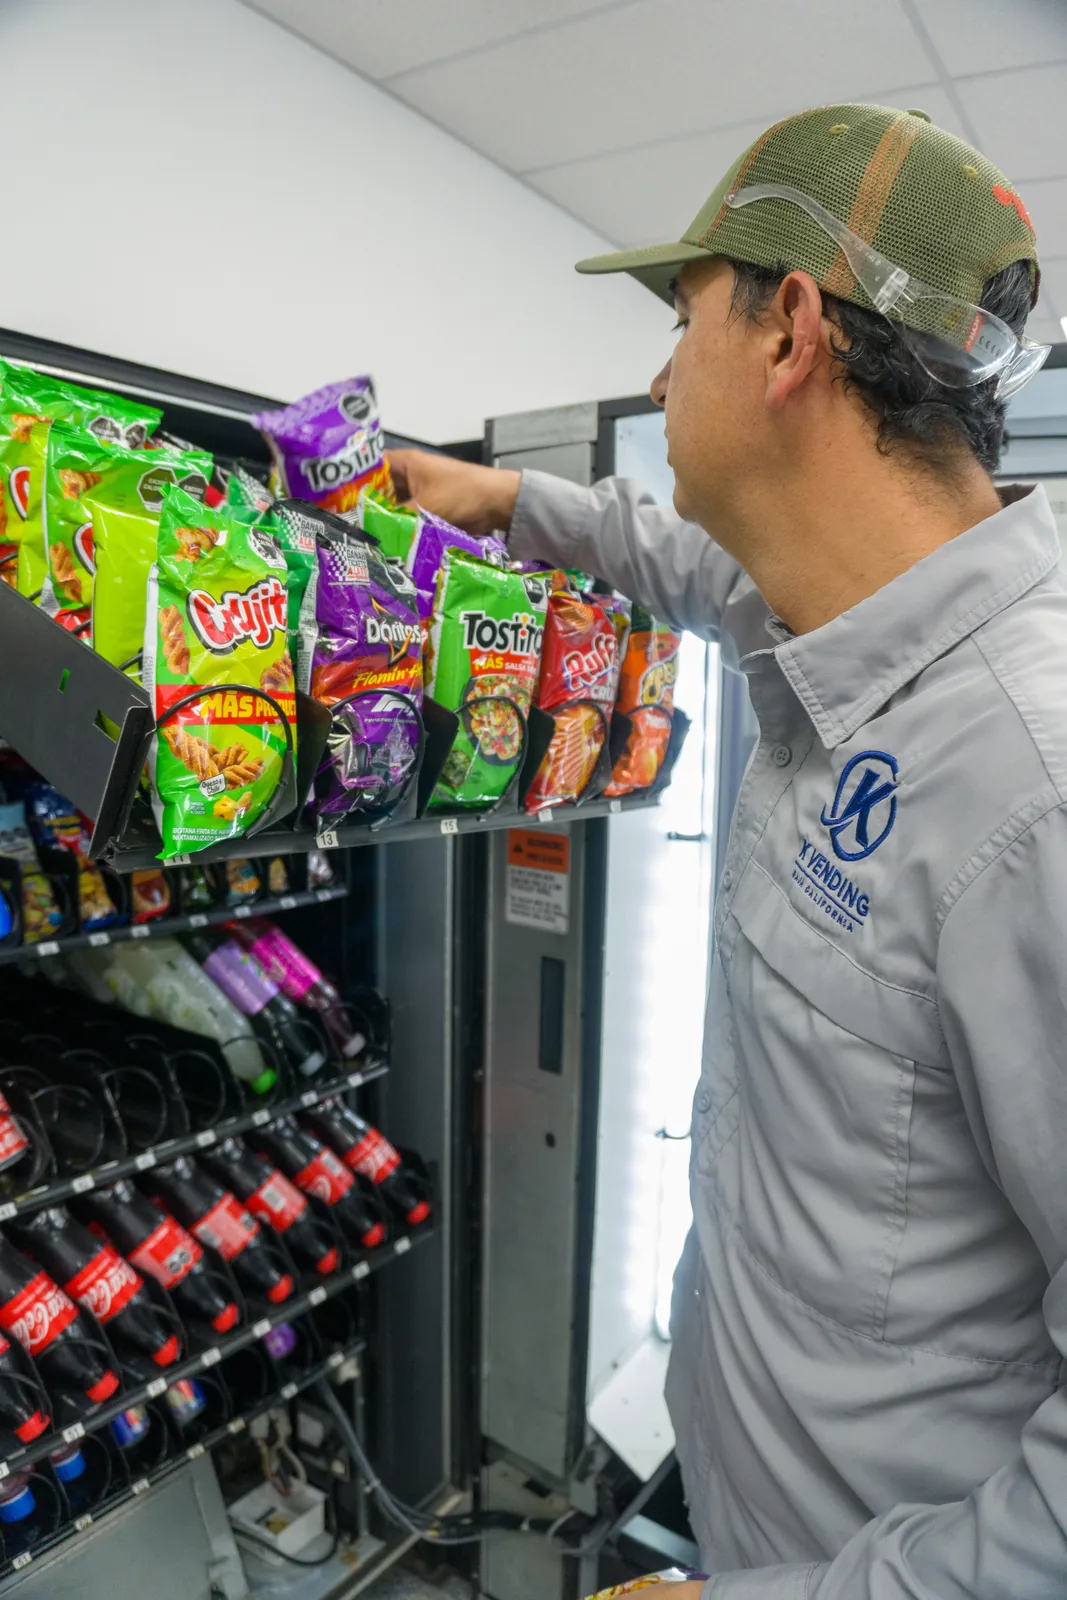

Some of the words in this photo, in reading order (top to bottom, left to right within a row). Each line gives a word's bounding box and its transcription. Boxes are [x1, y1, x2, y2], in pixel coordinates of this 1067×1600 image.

[301, 529, 316, 539] TICKE
[187, 575, 287, 650] Crujit
[366, 618, 421, 643] Doritos
[320, 833, 333, 846] 13
[806, 848, 870, 917] VENDING
[804, 885, 853, 933] CALIFORNIA
